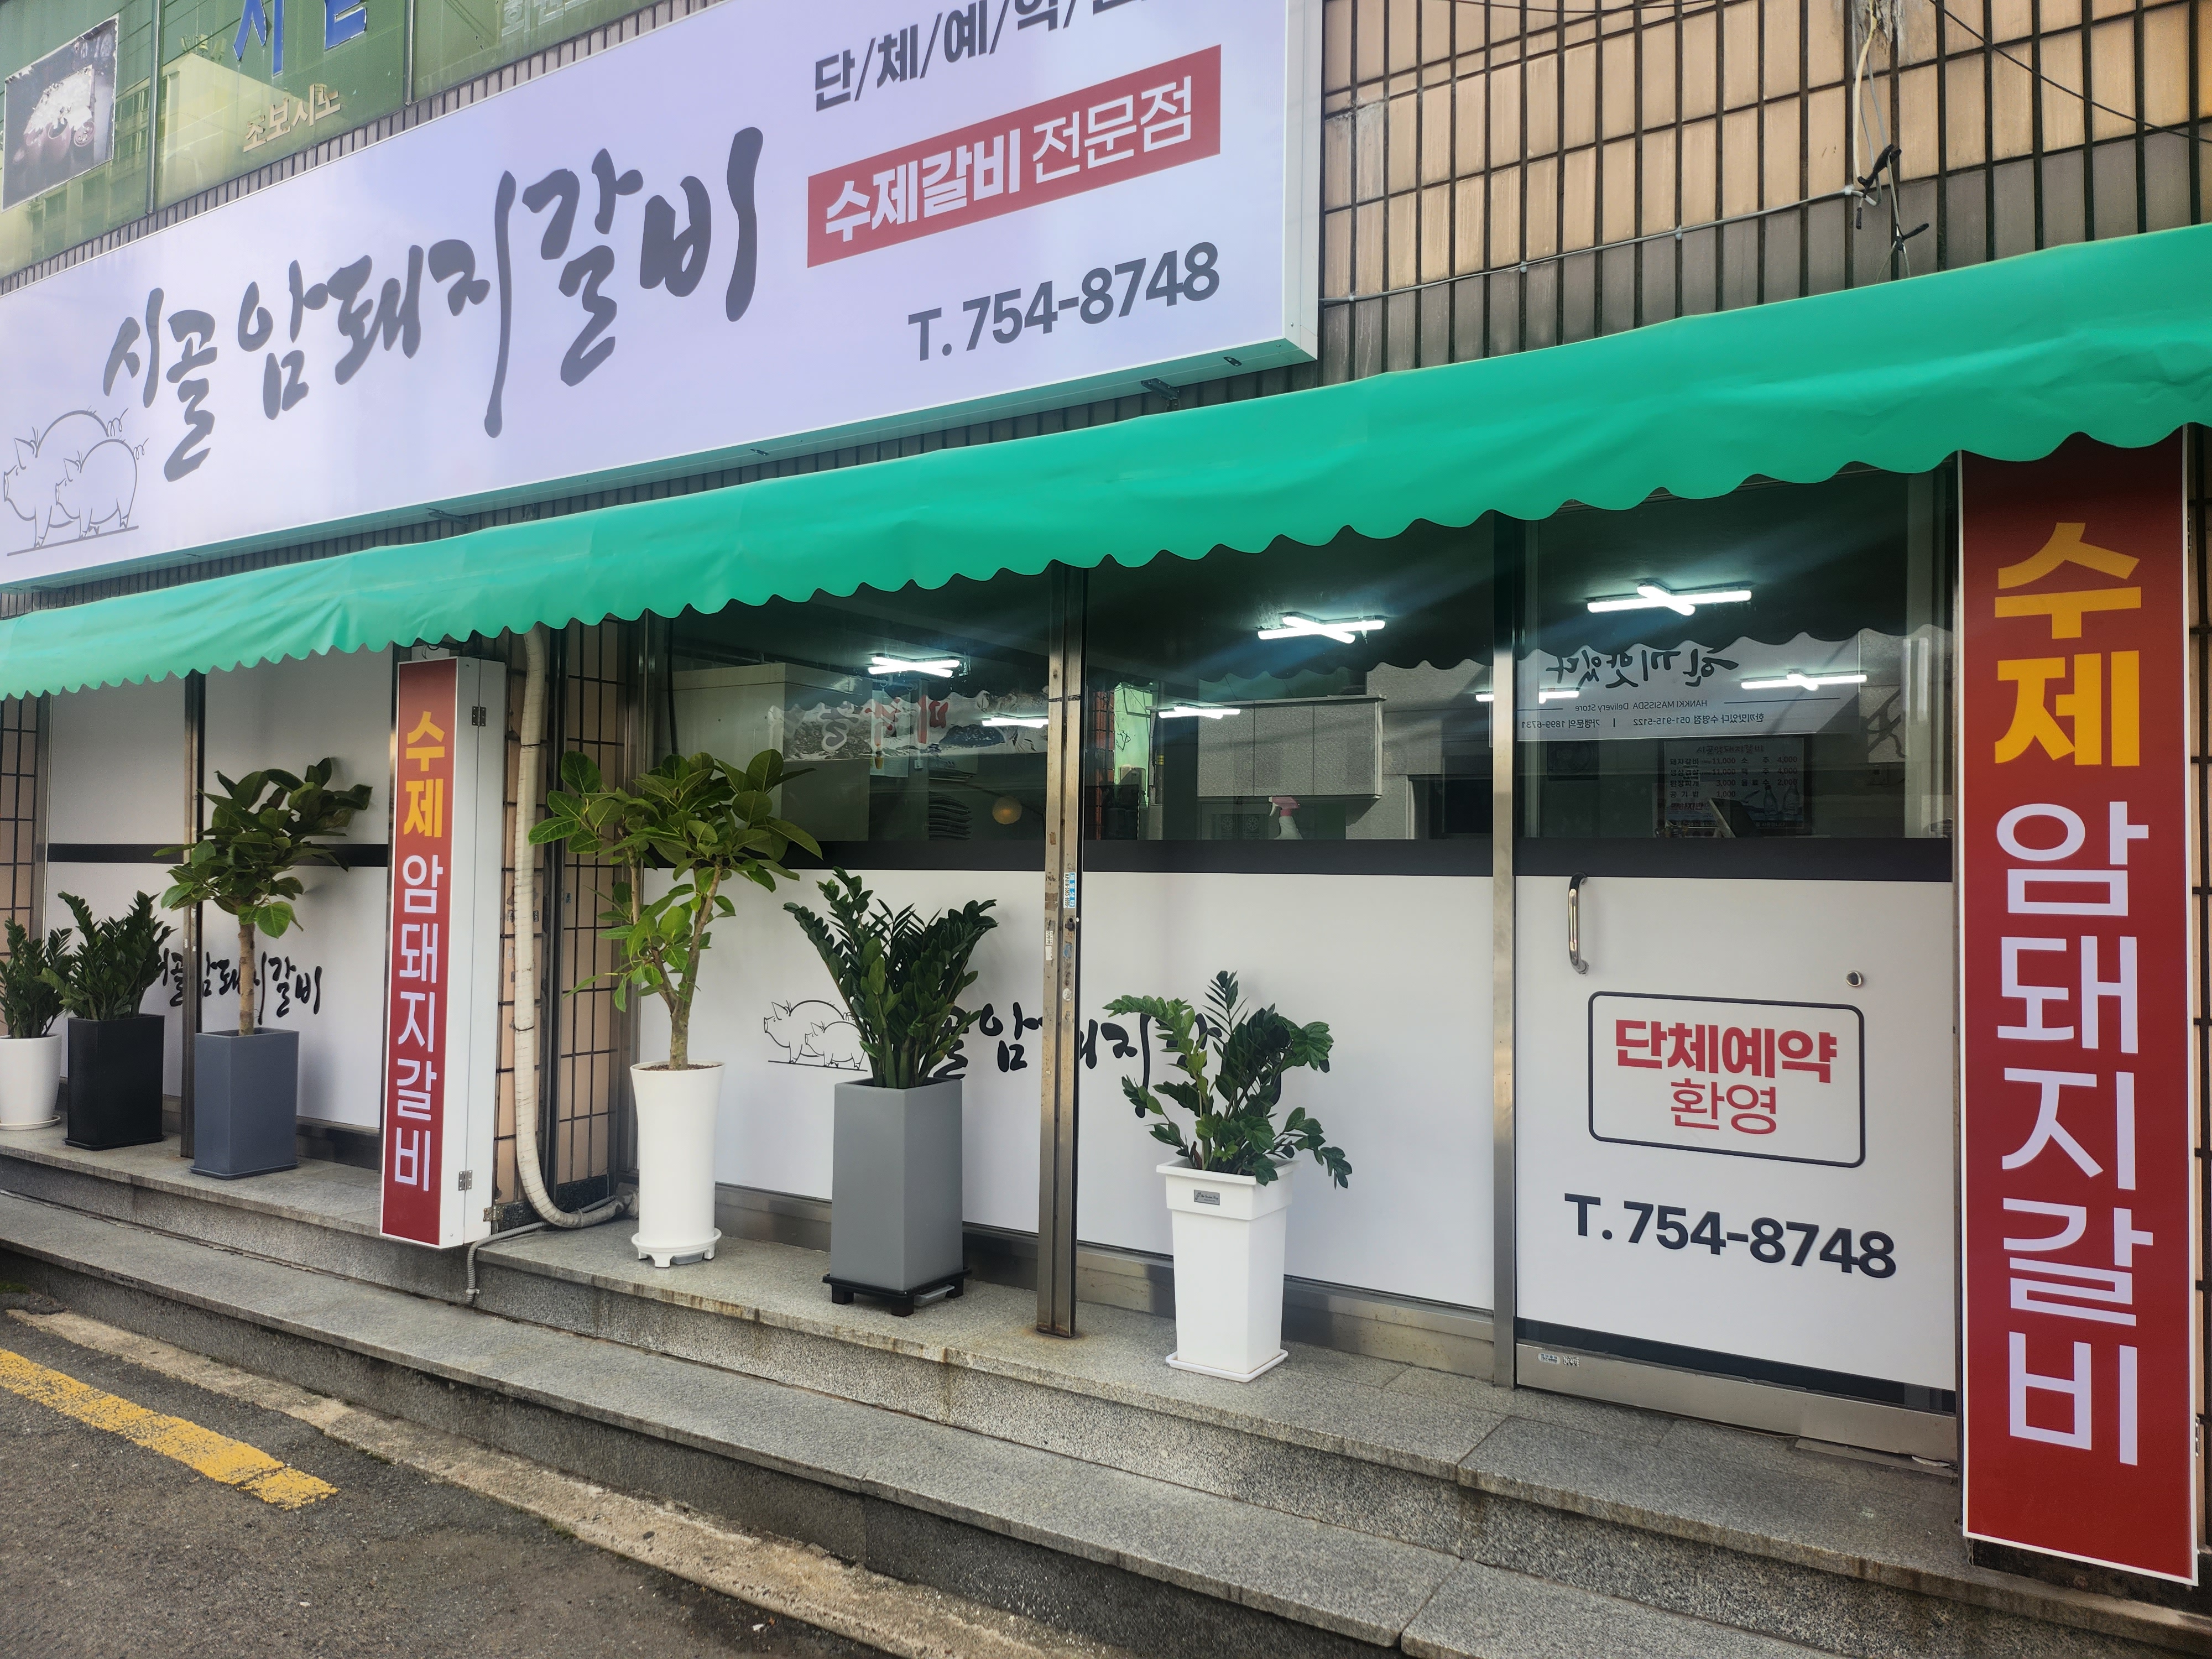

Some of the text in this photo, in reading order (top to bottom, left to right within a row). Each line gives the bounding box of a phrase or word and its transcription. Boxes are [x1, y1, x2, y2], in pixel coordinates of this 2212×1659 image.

[826, 76, 1191, 242] 수제갈비 전문점
[395, 711, 445, 1192] 수제 암돼지갈비
[1995, 522, 2154, 1467] 수제 암돼지갈비
[1616, 1019, 1838, 1083] 단체예약
[1671, 1078, 1777, 1135] 환영
